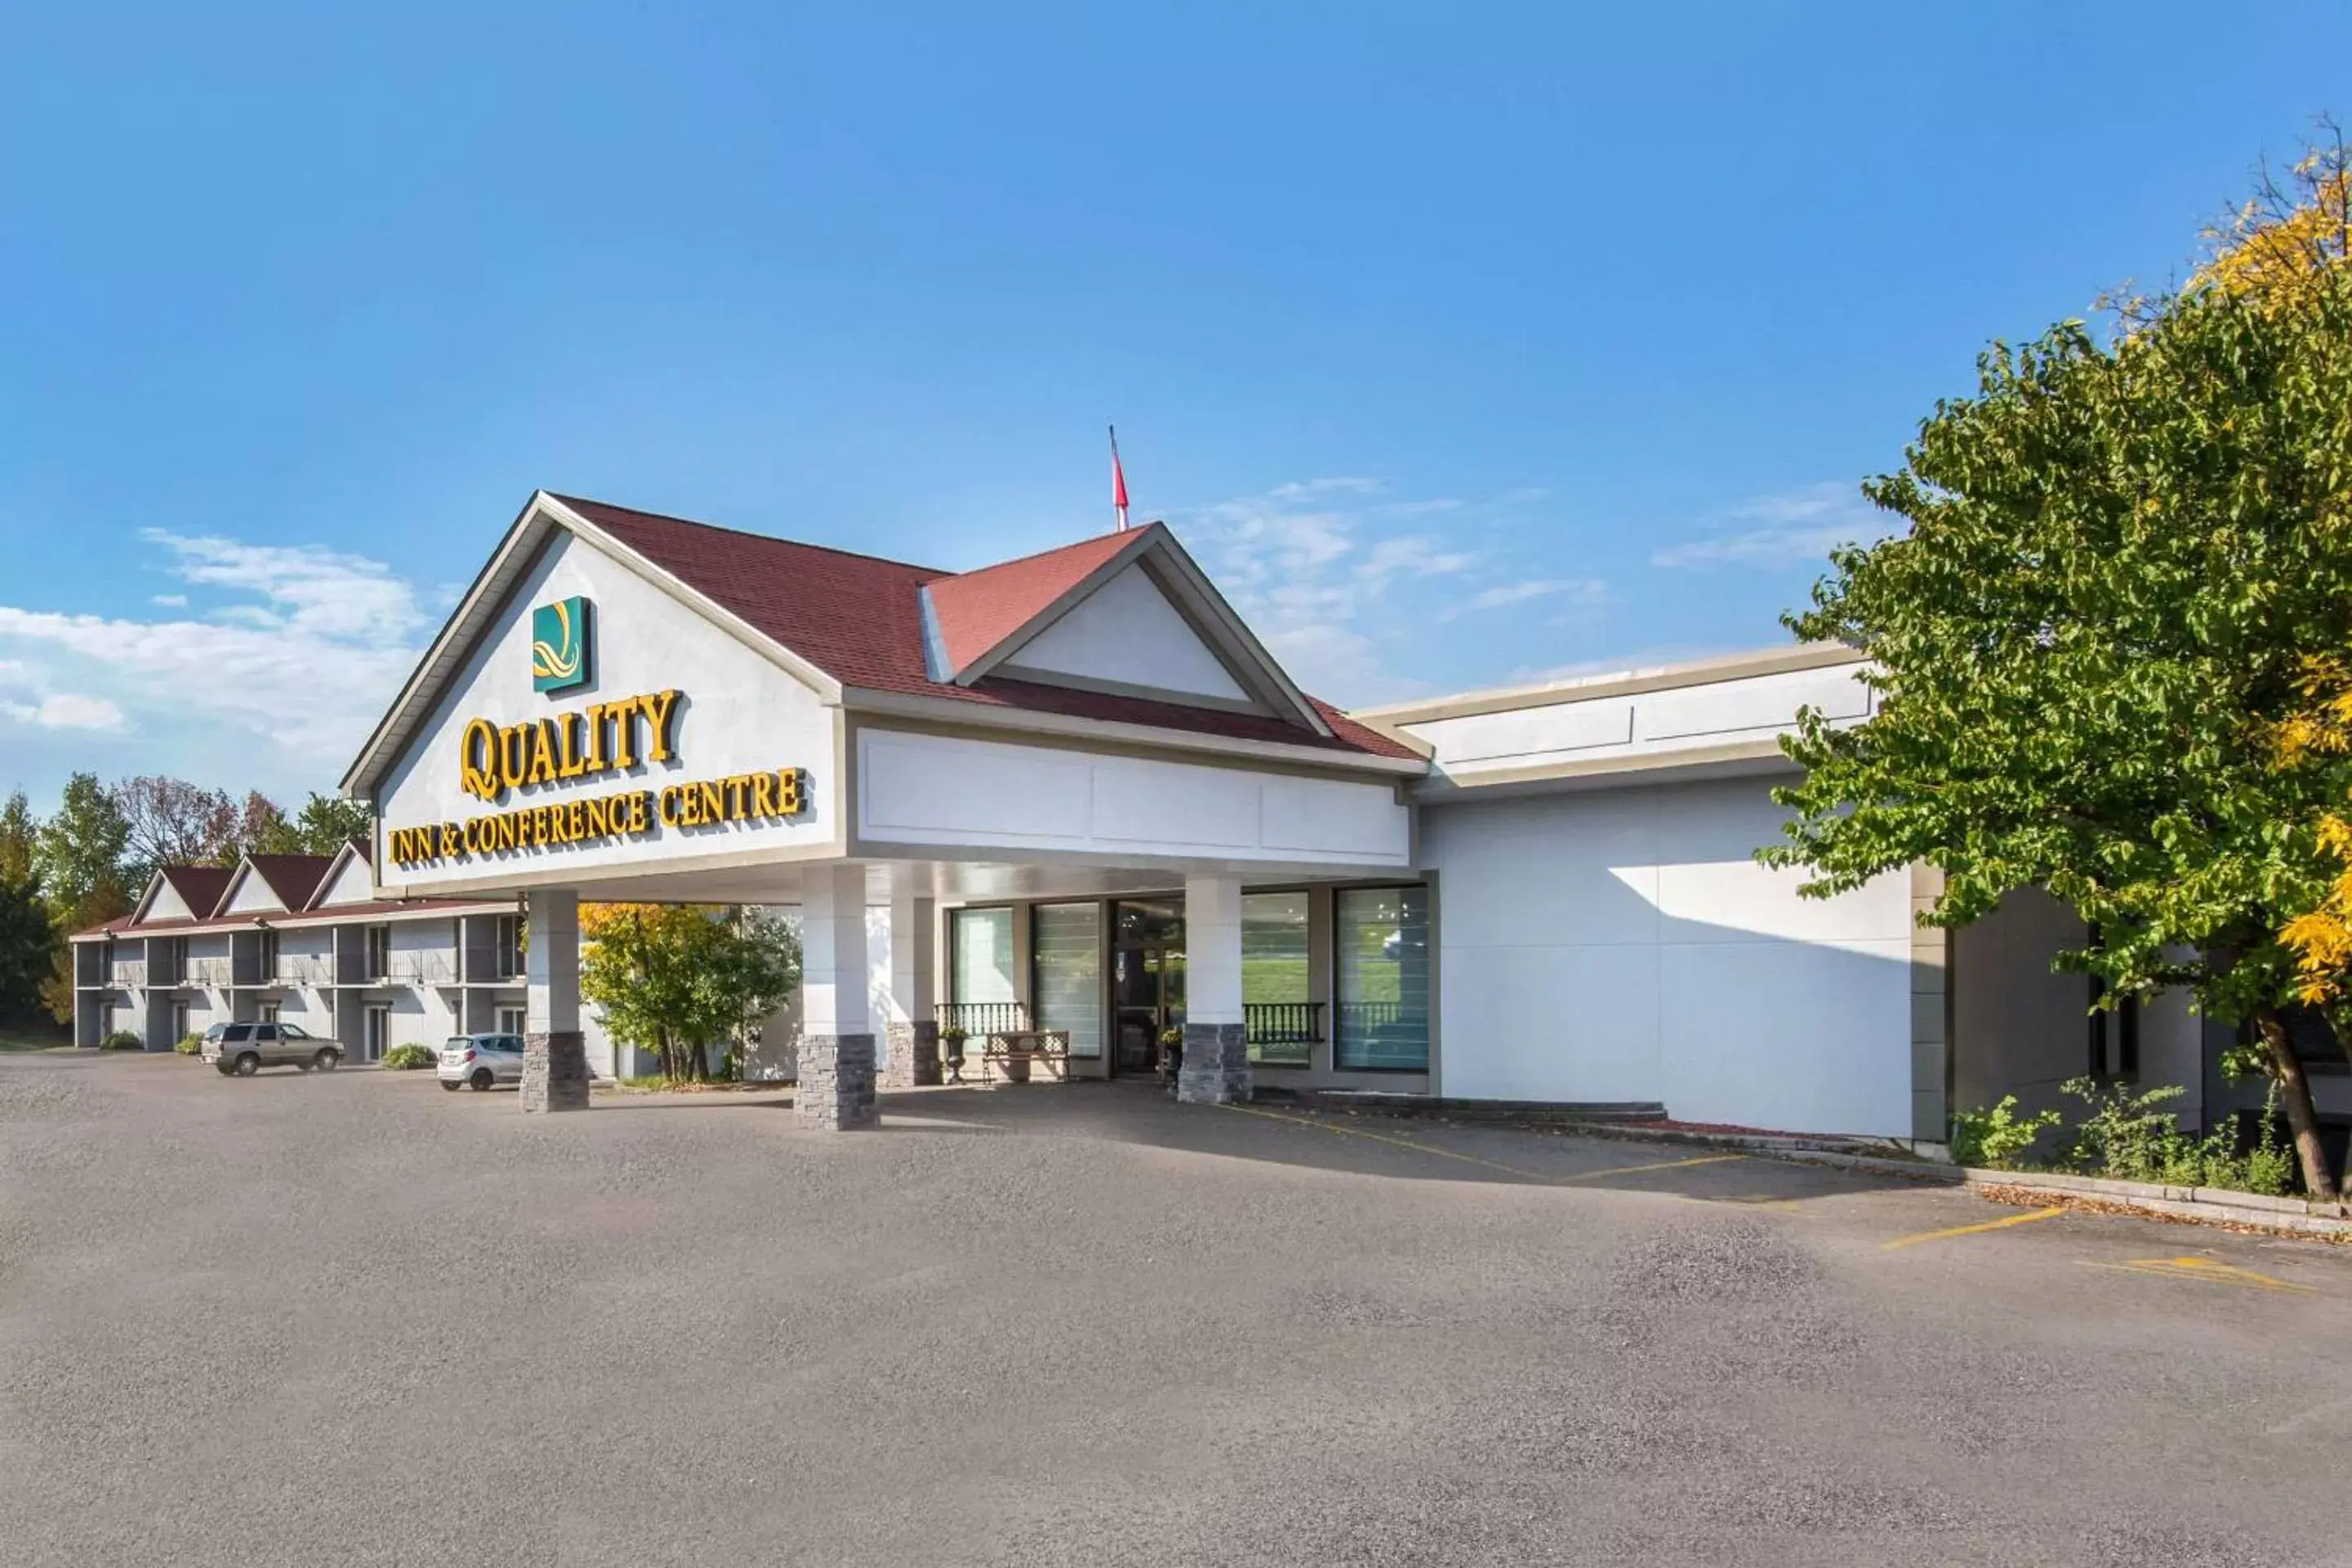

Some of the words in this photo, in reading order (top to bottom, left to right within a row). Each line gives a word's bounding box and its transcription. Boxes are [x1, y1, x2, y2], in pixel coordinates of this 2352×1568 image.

[460, 688, 679, 801] QUALITY
[388, 824, 434, 864] INN
[439, 821, 460, 858] &
[463, 789, 647, 853] CONFERENCE
[658, 766, 802, 828] CENTRE
